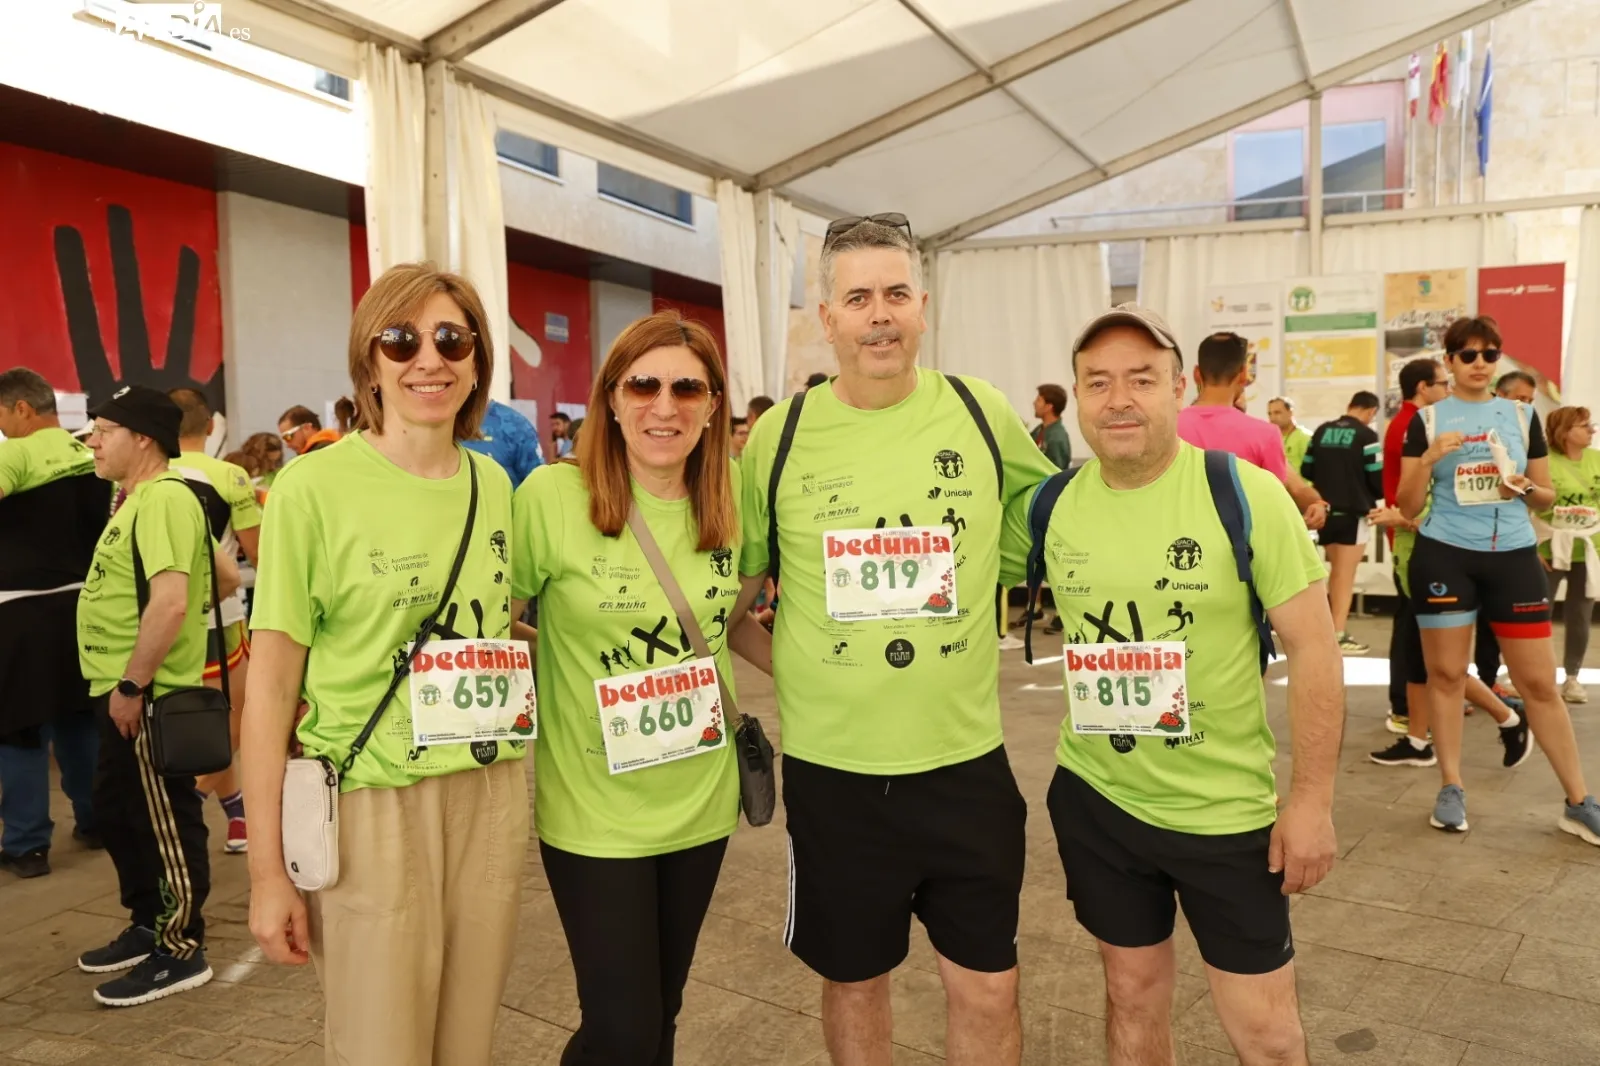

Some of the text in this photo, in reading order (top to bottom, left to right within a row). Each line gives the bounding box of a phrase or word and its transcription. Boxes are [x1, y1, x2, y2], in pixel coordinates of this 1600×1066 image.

[1320, 427, 1356, 445] AVS
[1457, 464, 1499, 476] bedun
[944, 488, 973, 499] Unicaja
[827, 531, 950, 559] bedunia
[860, 559, 920, 591] 819
[1172, 581, 1209, 592] Unicaja
[413, 645, 530, 673] bedunia
[1066, 647, 1183, 672] bedunia
[453, 675, 510, 710] 659
[600, 666, 716, 709] bedunia
[1096, 676, 1151, 707] 815
[639, 697, 694, 737] 660
